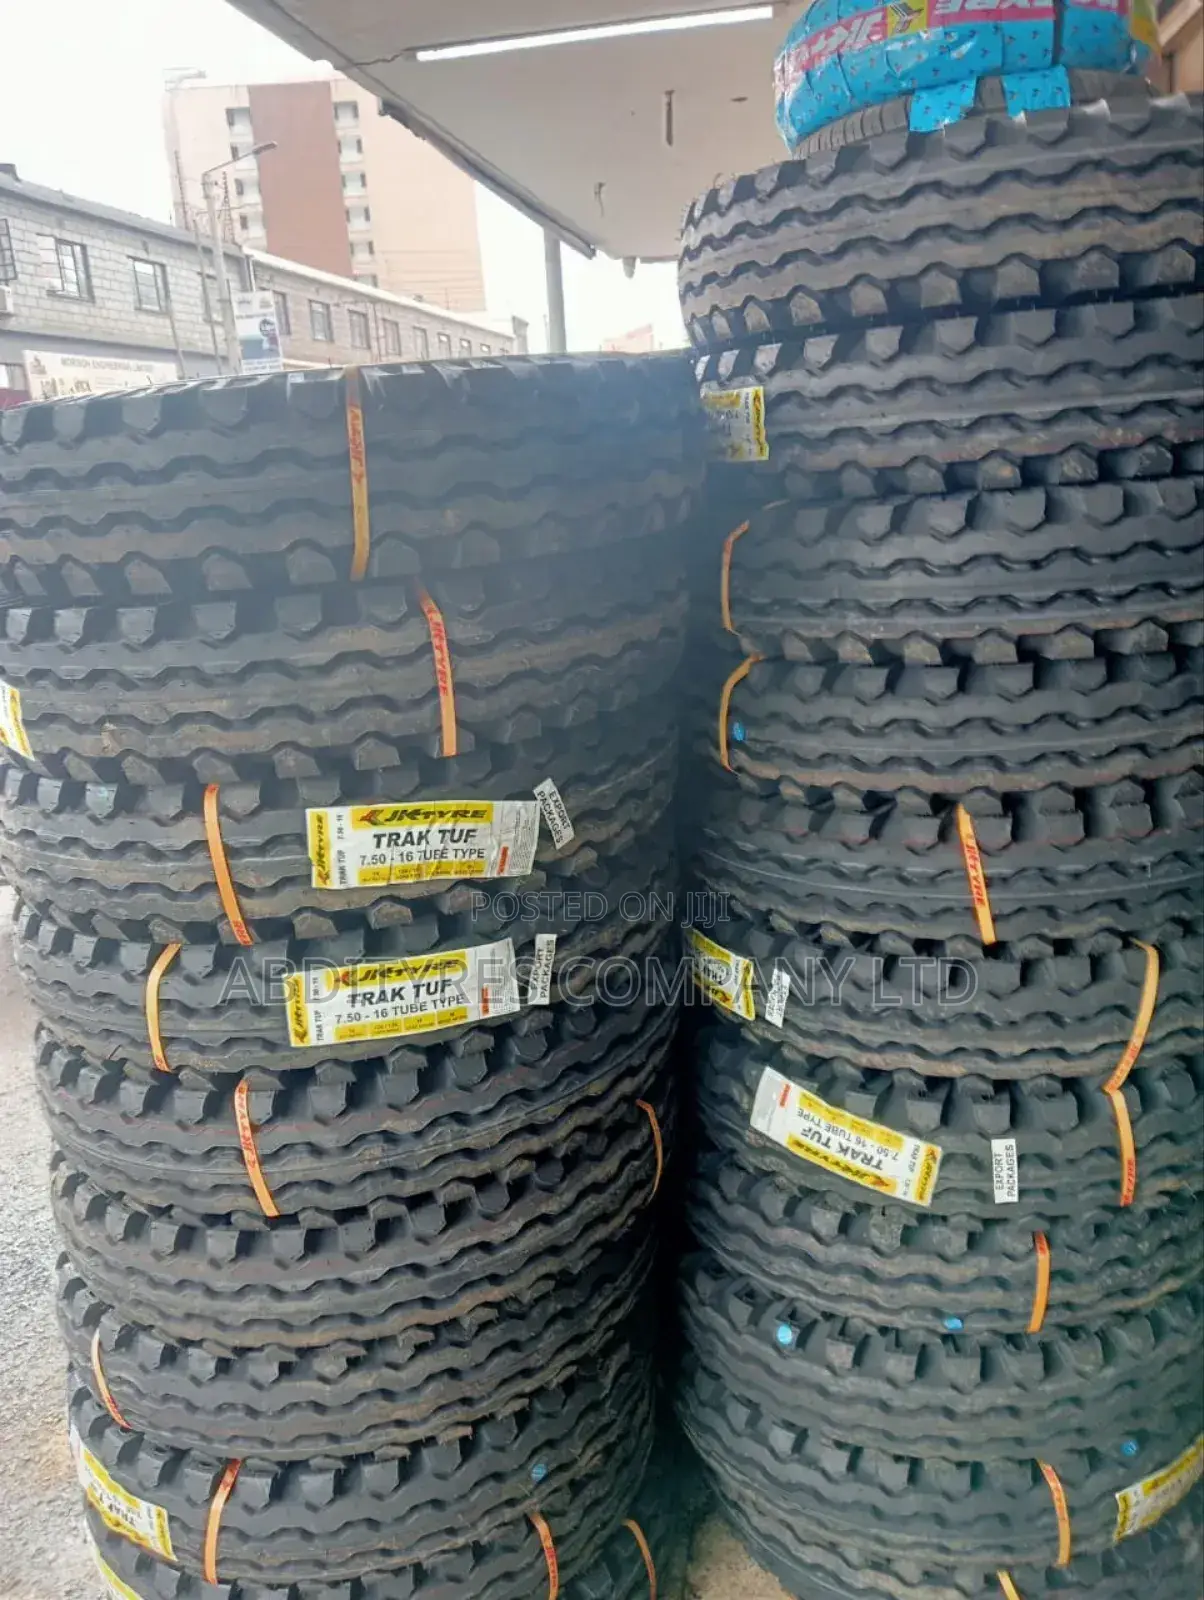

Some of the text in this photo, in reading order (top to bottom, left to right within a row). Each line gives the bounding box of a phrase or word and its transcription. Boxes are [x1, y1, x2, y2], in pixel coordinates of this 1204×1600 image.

[537, 791, 564, 844] PACKAGES
[550, 789, 571, 830] EXPORT
[373, 828, 477, 850] TRAK TUF
[360, 853, 386, 866] 7.50
[399, 852, 413, 863] 16
[418, 848, 449, 862] TUBE
[453, 848, 485, 860] TYPE
[539, 939, 554, 999] PACKAGES
[350, 979, 453, 1008] TRAK TUF
[335, 1011, 361, 1025] 7.50
[374, 1007, 388, 1020] 16
[393, 1002, 427, 1016] TUBE
[431, 993, 465, 1010] TYPE
[796, 1107, 822, 1129] TYPE
[825, 1123, 852, 1143] TUBE
[800, 1126, 883, 1172] TRAK TUF
[855, 1136, 867, 1148] 16
[875, 1146, 898, 1161] 7.50
[995, 1153, 1004, 1190] EXPORT
[1006, 1144, 1015, 1197] PACKAGES
